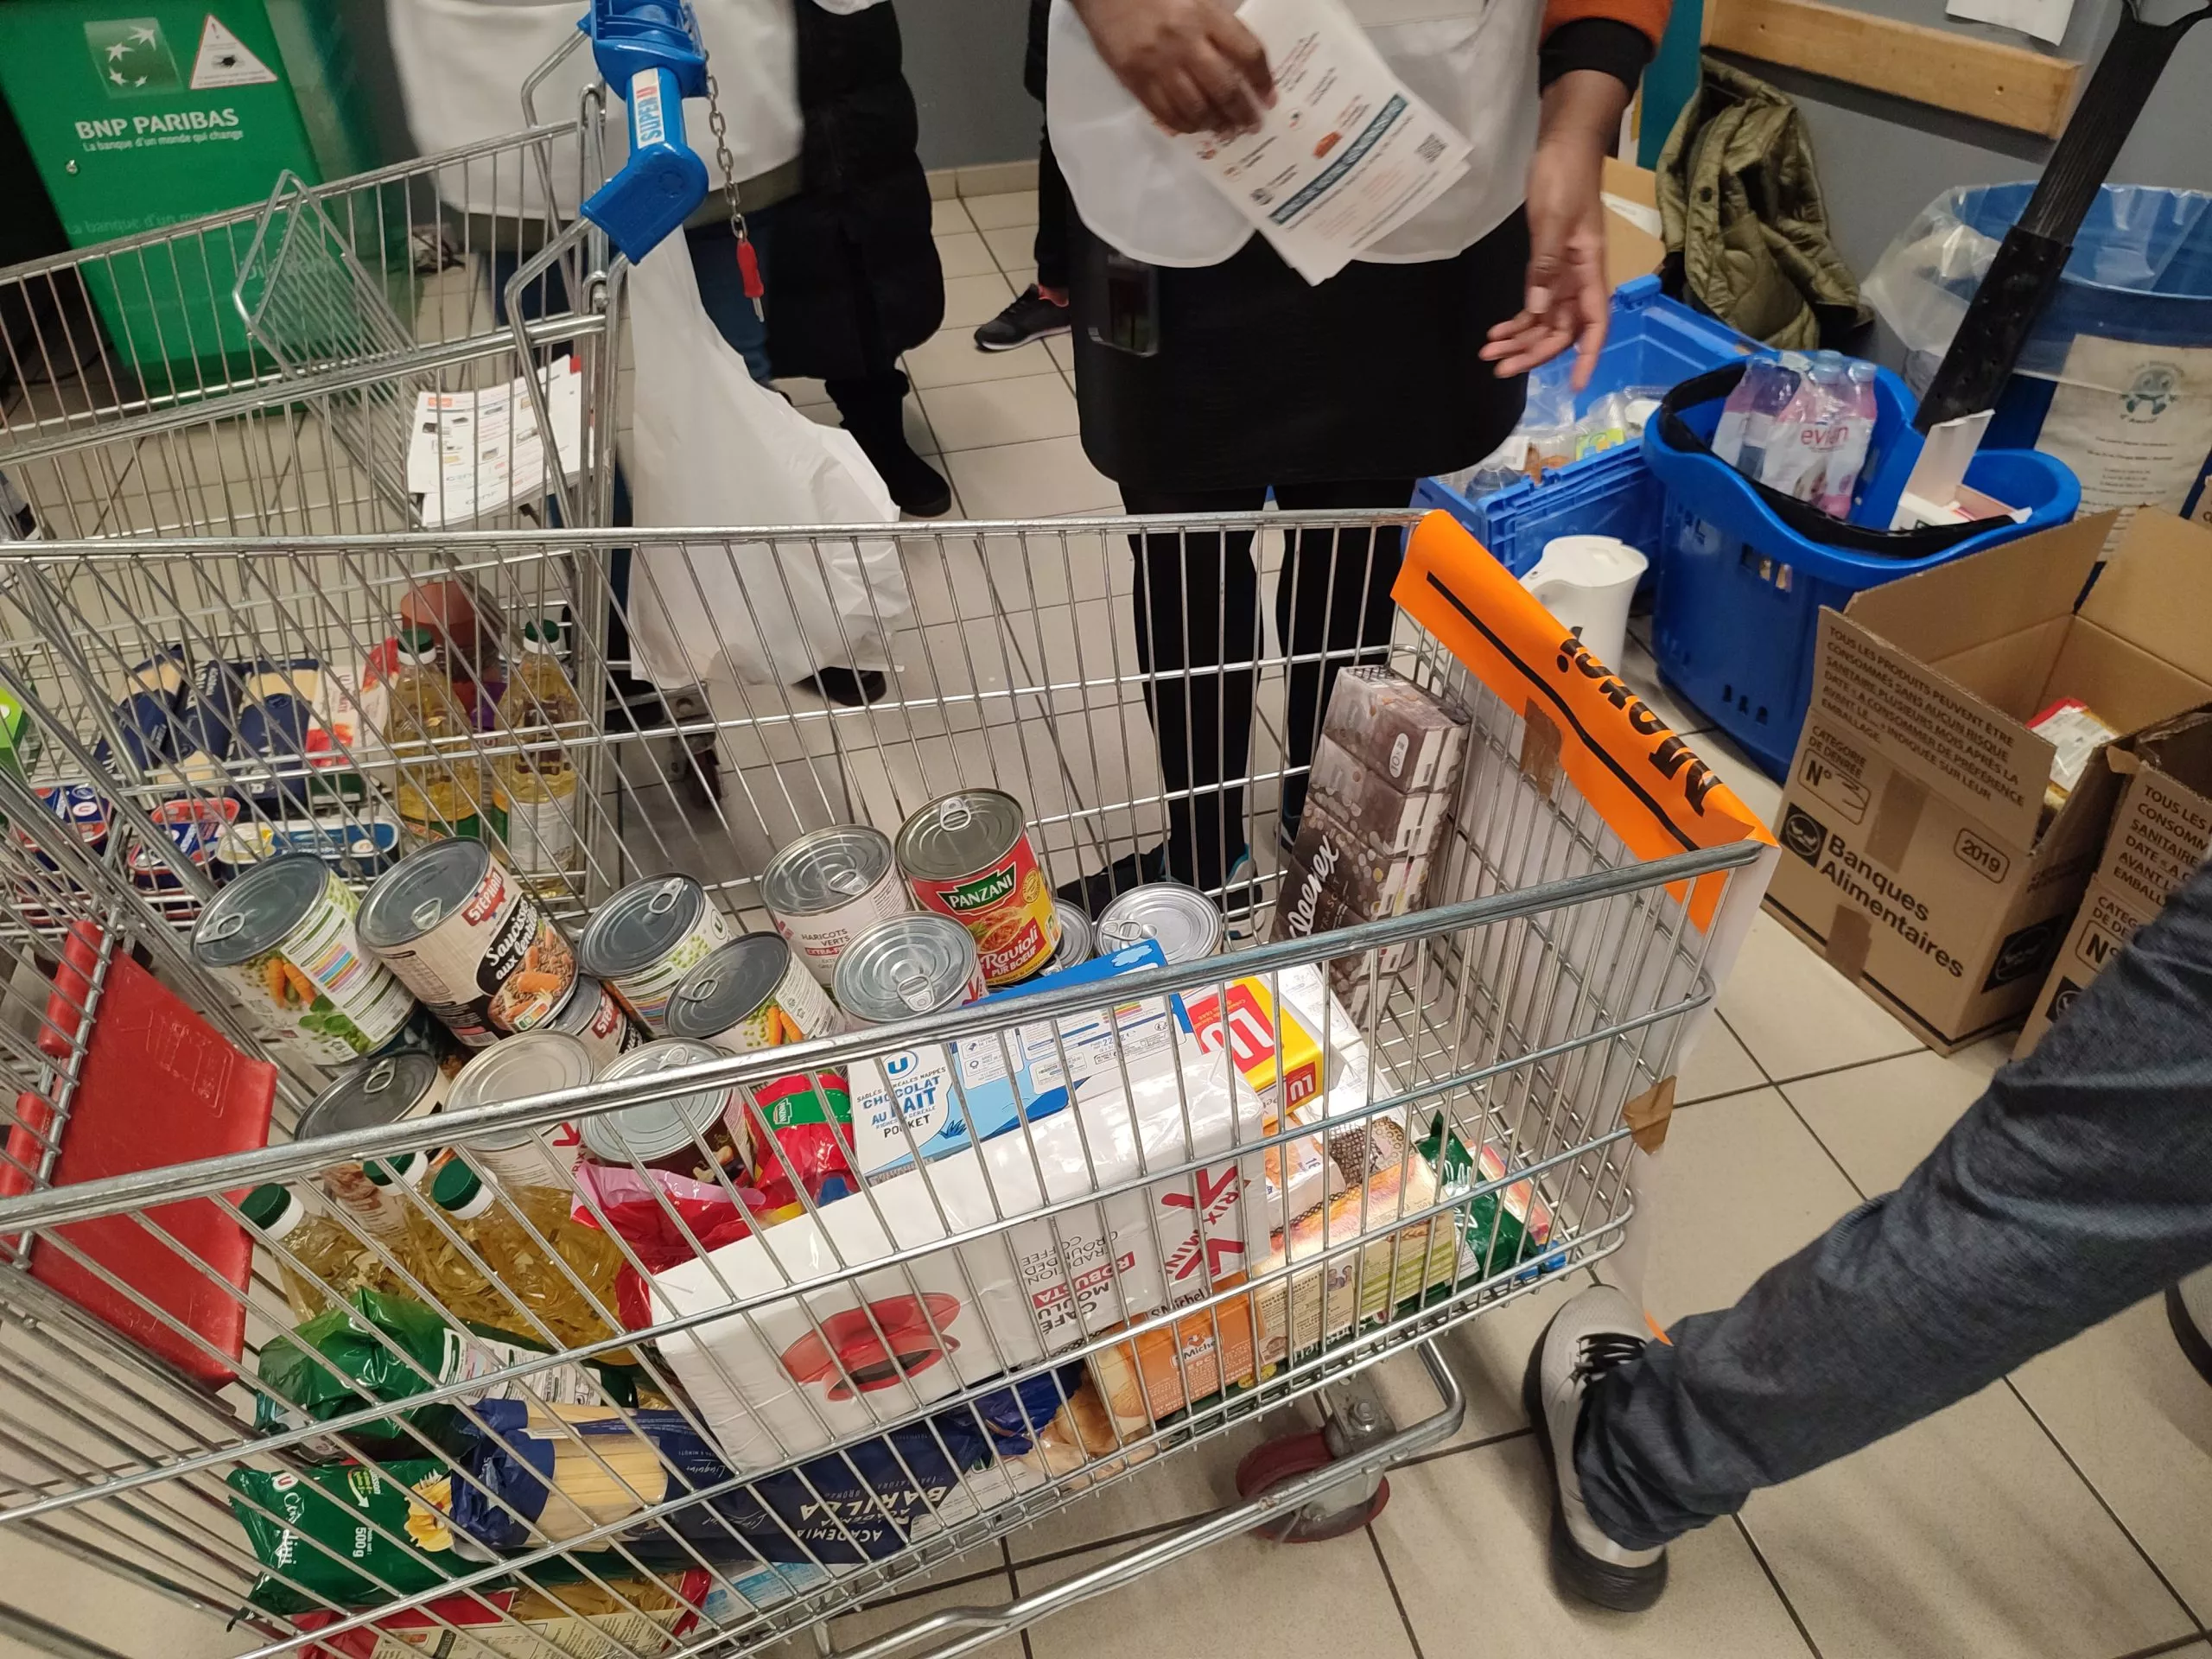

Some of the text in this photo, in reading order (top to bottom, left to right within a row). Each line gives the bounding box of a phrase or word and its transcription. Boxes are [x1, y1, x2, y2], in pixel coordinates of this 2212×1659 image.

[74, 108, 239, 140] BNP PARIBAS
[638, 97, 663, 142] SUPER
[83, 130, 244, 152] La banque d'un monde qui change
[1827, 642, 2009, 763] CONSOMMÉS SANS AUCUN RISQUE
[1829, 626, 2015, 747] TOUS LES PRODUITS PEUVENT ÊTRE
[1808, 735, 1823, 750] DE
[1823, 685, 1857, 711] AVANT
[1887, 725, 1937, 766] INDIQUÉE
[1938, 760, 1961, 783] SUR
[1962, 774, 1993, 802] LEUR
[1824, 671, 1848, 691] DATE
[1866, 697, 1936, 753] CONSOMMER
[1936, 743, 1951, 758] DE
[1953, 752, 2025, 807] PRÉFÉRENCE
[1878, 689, 1934, 731] PLUSIEURS
[1935, 722, 1964, 753] MOIS
[1965, 743, 2002, 774] APRÈS
[2003, 767, 2019, 786] LA
[1805, 760, 1833, 787] N°
[2145, 785, 2205, 830] TOUS LES
[1961, 839, 2001, 873] 2019
[2126, 835, 2158, 862] DATE
[2130, 819, 2200, 868] SANITAIRE
[1827, 833, 1930, 923] Banques
[2119, 852, 2163, 885] AVANT
[949, 874, 1014, 908] PANZANI
[1819, 861, 1965, 979] Alimentaires
[2093, 907, 2110, 925] DE
[802, 928, 849, 941] HARICOTS
[820, 936, 850, 946] VERTS
[980, 925, 1039, 970] Ravioli
[495, 958, 519, 981] aux
[991, 945, 1038, 977] PUR BOEUF
[1201, 1007, 1275, 1060] LU
[887, 1056, 909, 1075] U
[1289, 1074, 1314, 1102] LU
[872, 1112, 887, 1126] AU
[884, 1114, 931, 1138] POKET
[1021, 1236, 1082, 1267] COFFEE
[1038, 1281, 1109, 1319] MOULU
[1039, 1300, 1097, 1336] CAFÉ
[800, 1486, 947, 1522] BARILLA
[796, 1528, 883, 1542] ACADEMIA
